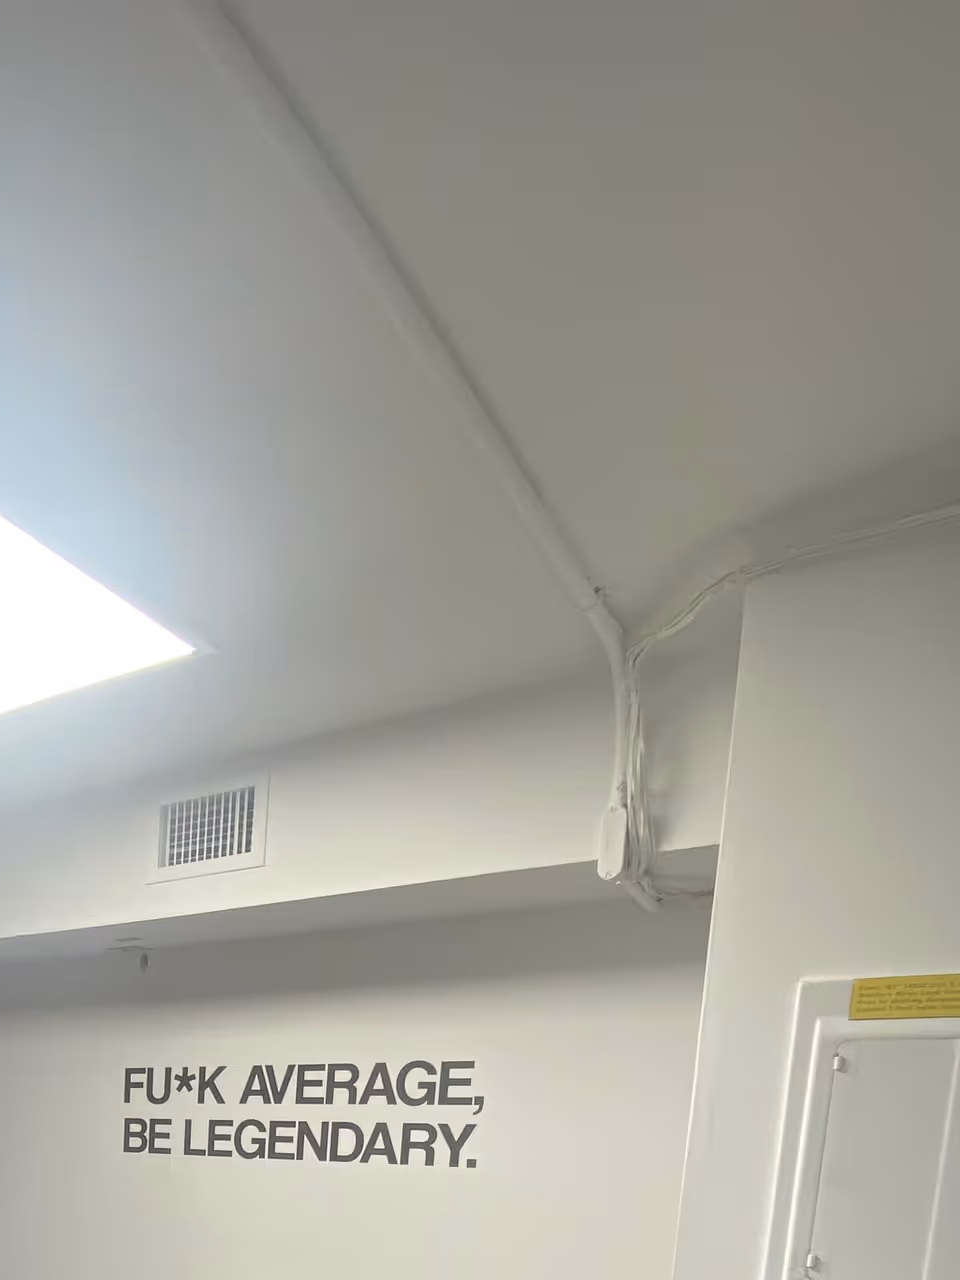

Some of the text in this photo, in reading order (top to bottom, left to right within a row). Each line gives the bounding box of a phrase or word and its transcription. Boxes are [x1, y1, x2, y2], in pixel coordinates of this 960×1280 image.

[239, 1060, 484, 1115] AVERAGE,
[123, 1117, 477, 1169] BE LEGENDARY.
